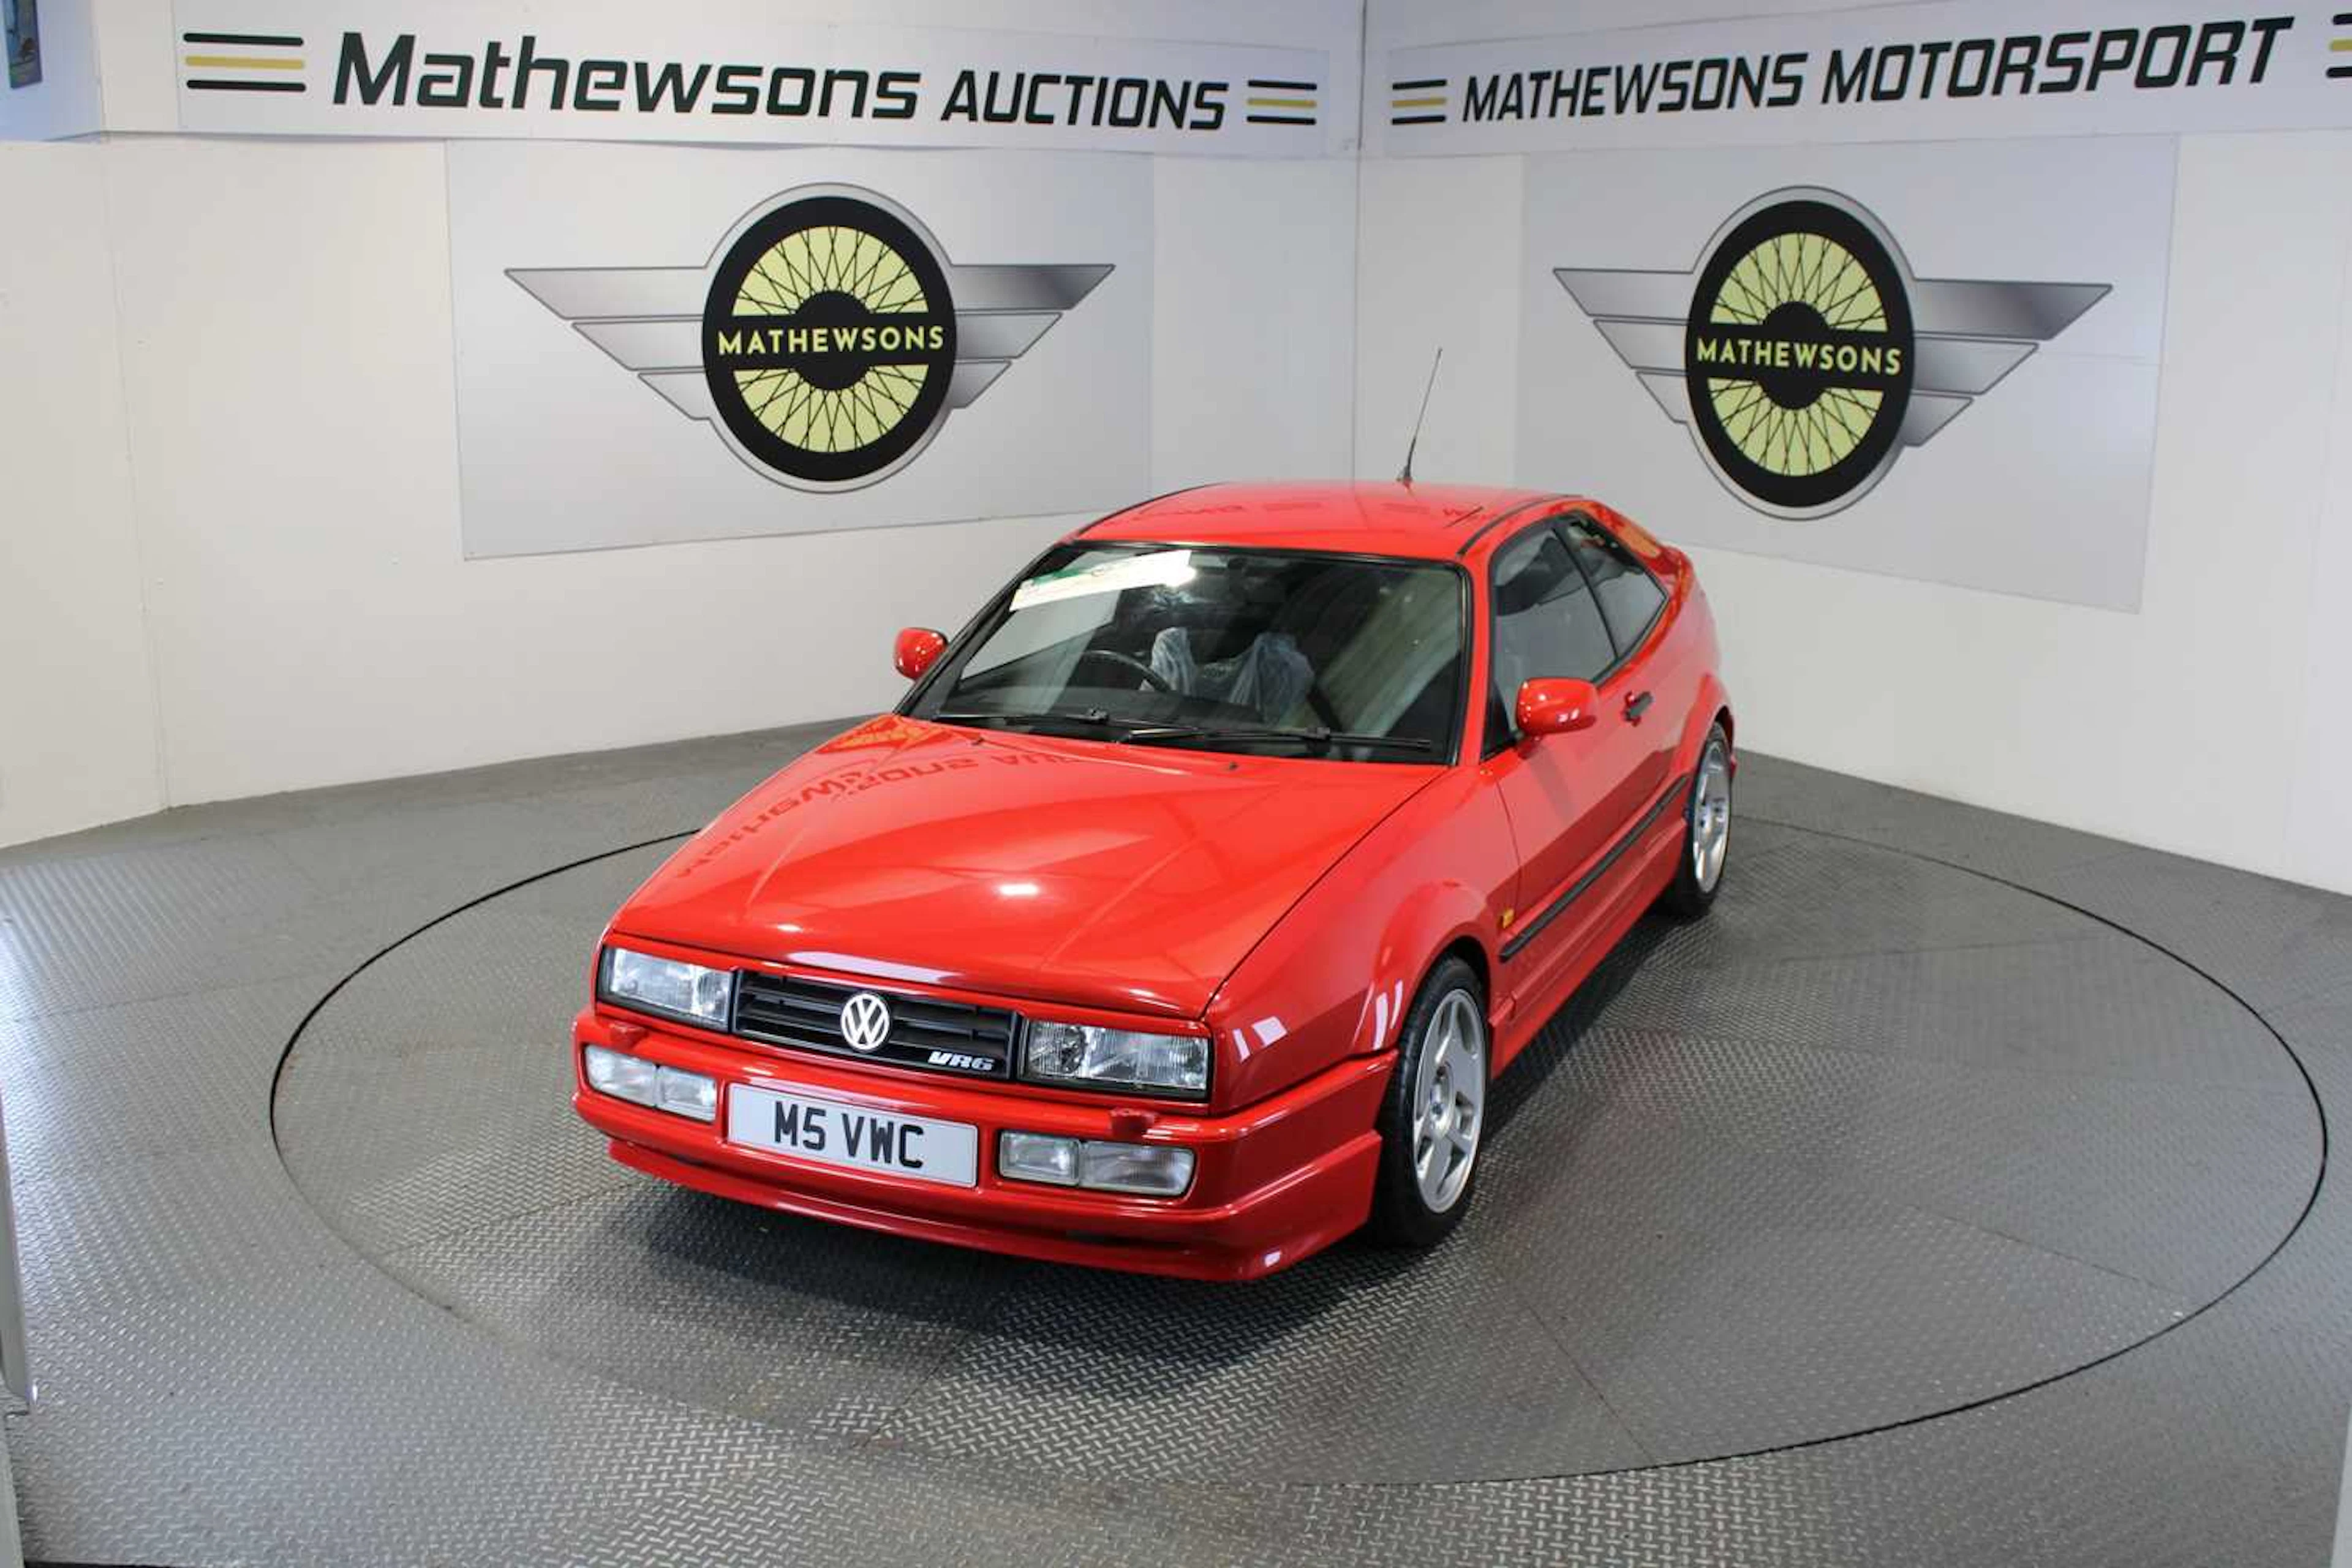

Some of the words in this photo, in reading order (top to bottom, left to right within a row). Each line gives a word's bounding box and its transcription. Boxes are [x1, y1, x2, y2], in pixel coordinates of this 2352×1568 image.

[333, 32, 921, 119] Mathewsons
[941, 70, 1229, 130] AUCTIONS
[1462, 53, 1809, 123] MATHEWSONS
[1821, 17, 2295, 105] MOTORSPORT
[718, 325, 943, 355] MATHEWSONS
[1697, 338, 1901, 375] MATHEWSONS
[927, 1051, 995, 1071] VR6
[774, 1101, 827, 1152] M5
[842, 1113, 924, 1169] VWC
